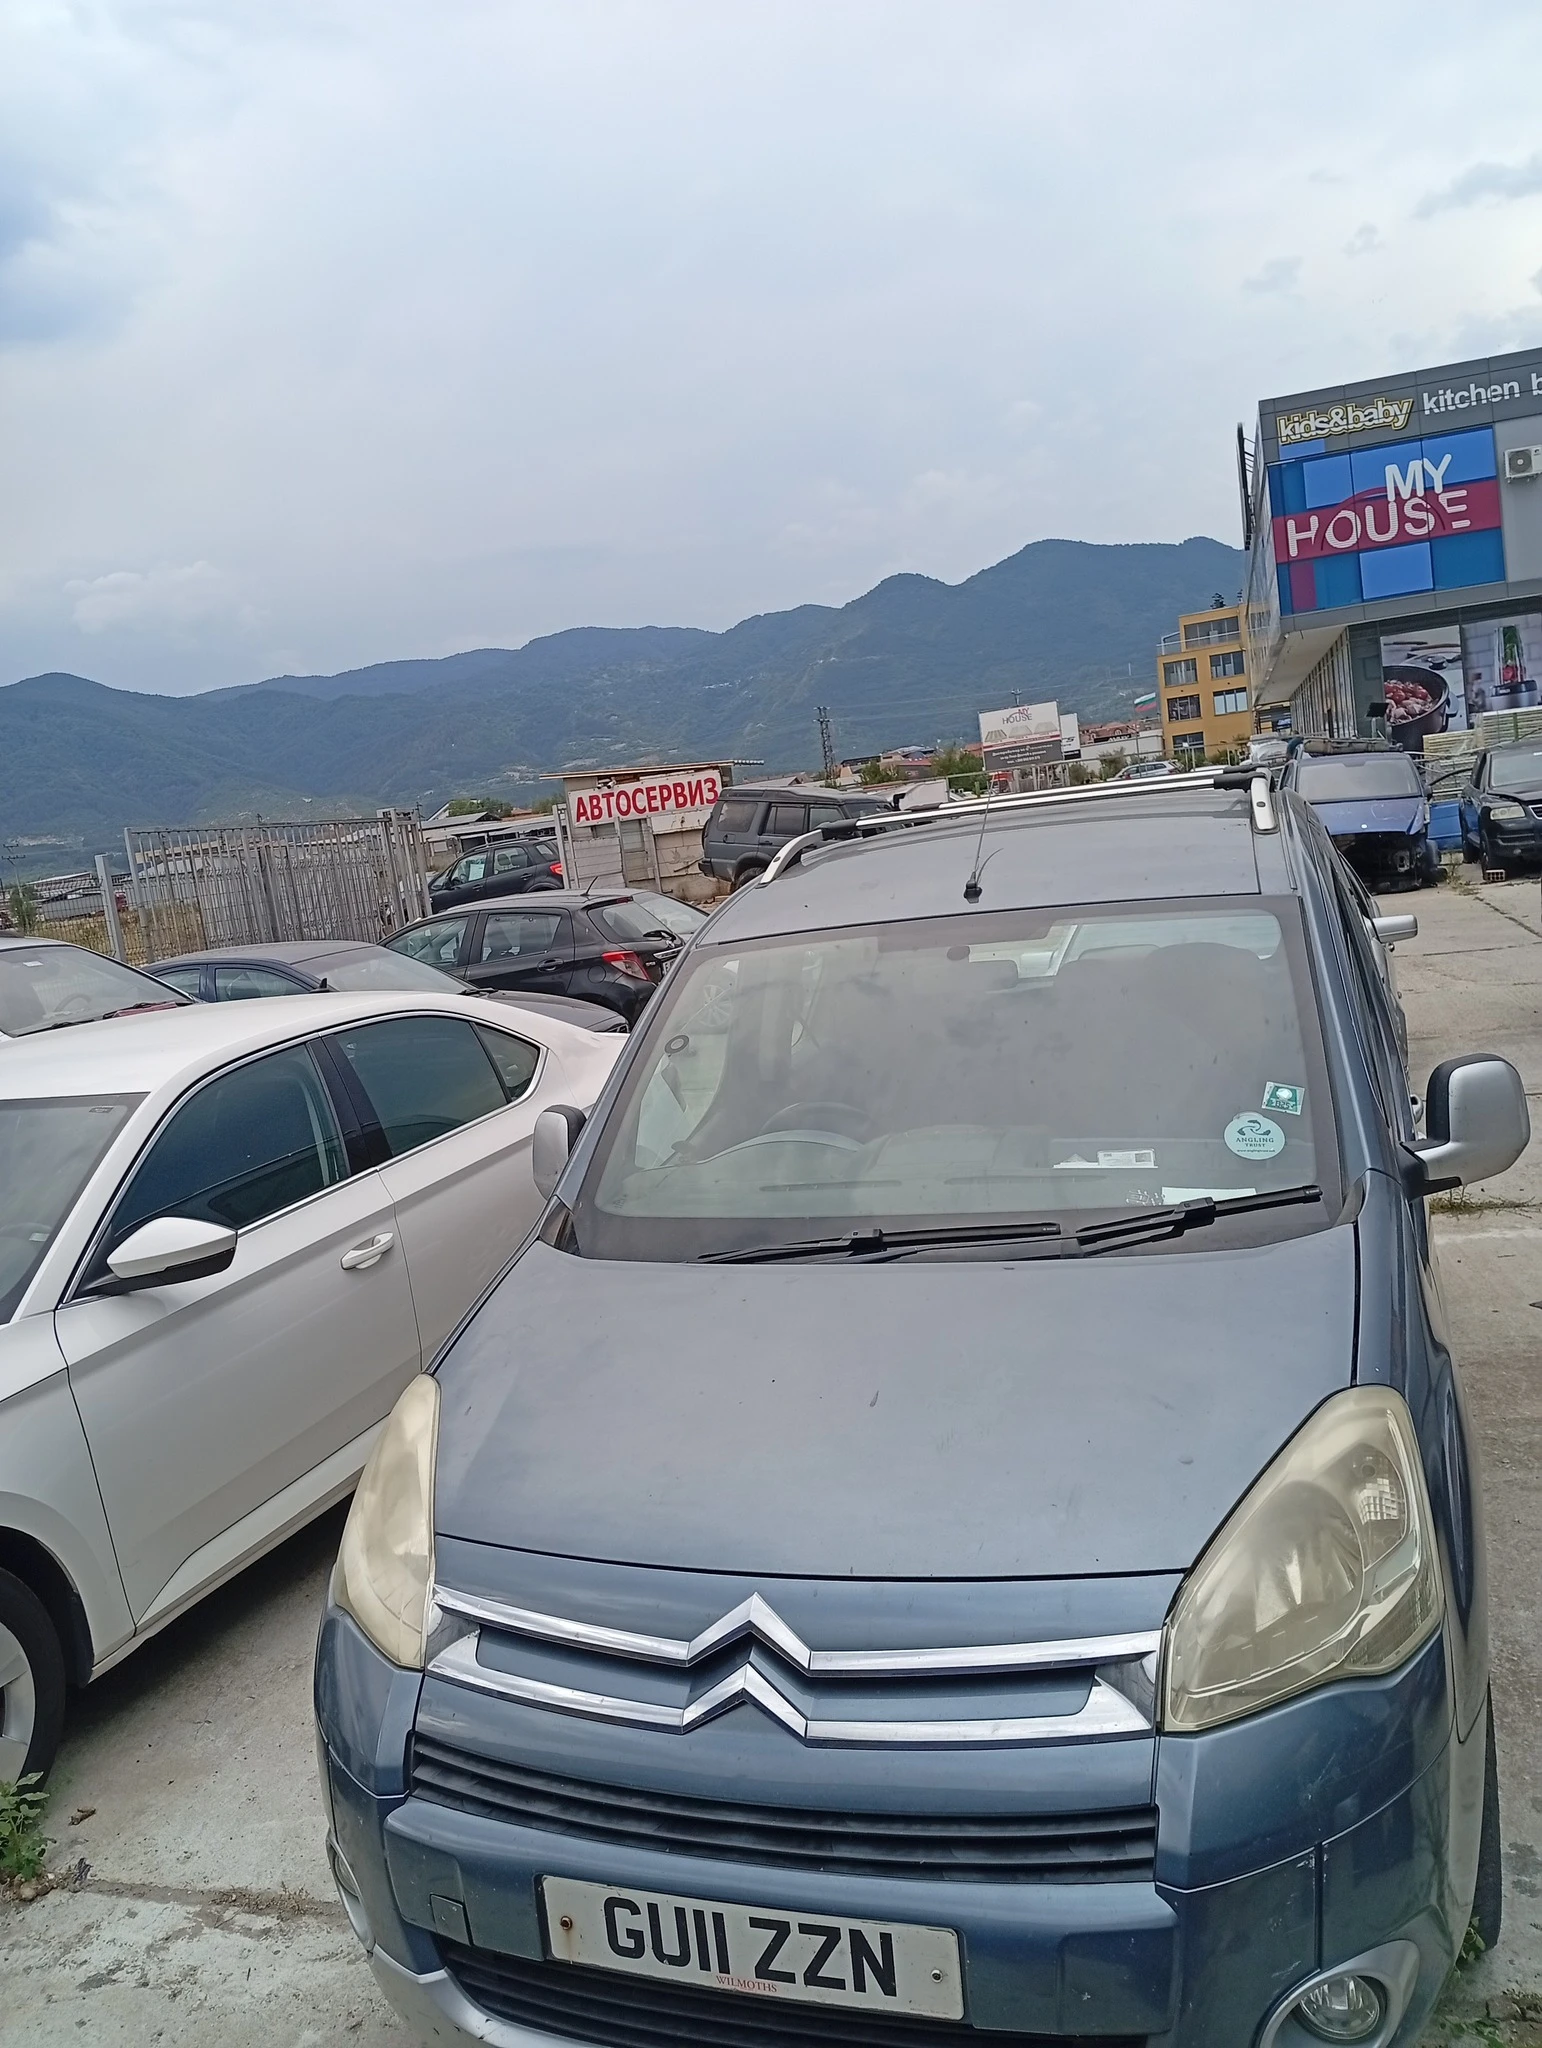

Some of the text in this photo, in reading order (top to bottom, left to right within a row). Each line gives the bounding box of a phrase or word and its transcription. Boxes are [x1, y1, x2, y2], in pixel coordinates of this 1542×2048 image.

[1277, 397, 1413, 445] kids&baby
[1422, 381, 1520, 415] kitchen
[1384, 453, 1452, 503] MY
[1286, 489, 1472, 558] HOUSE
[1002, 713, 1033, 725] HOUSE
[1018, 707, 1030, 715] MY
[575, 777, 719, 824] АВТОСЕРВИЗ
[748, 1915, 898, 1998] ZZN
[715, 1974, 778, 1993] WILMOTHS
